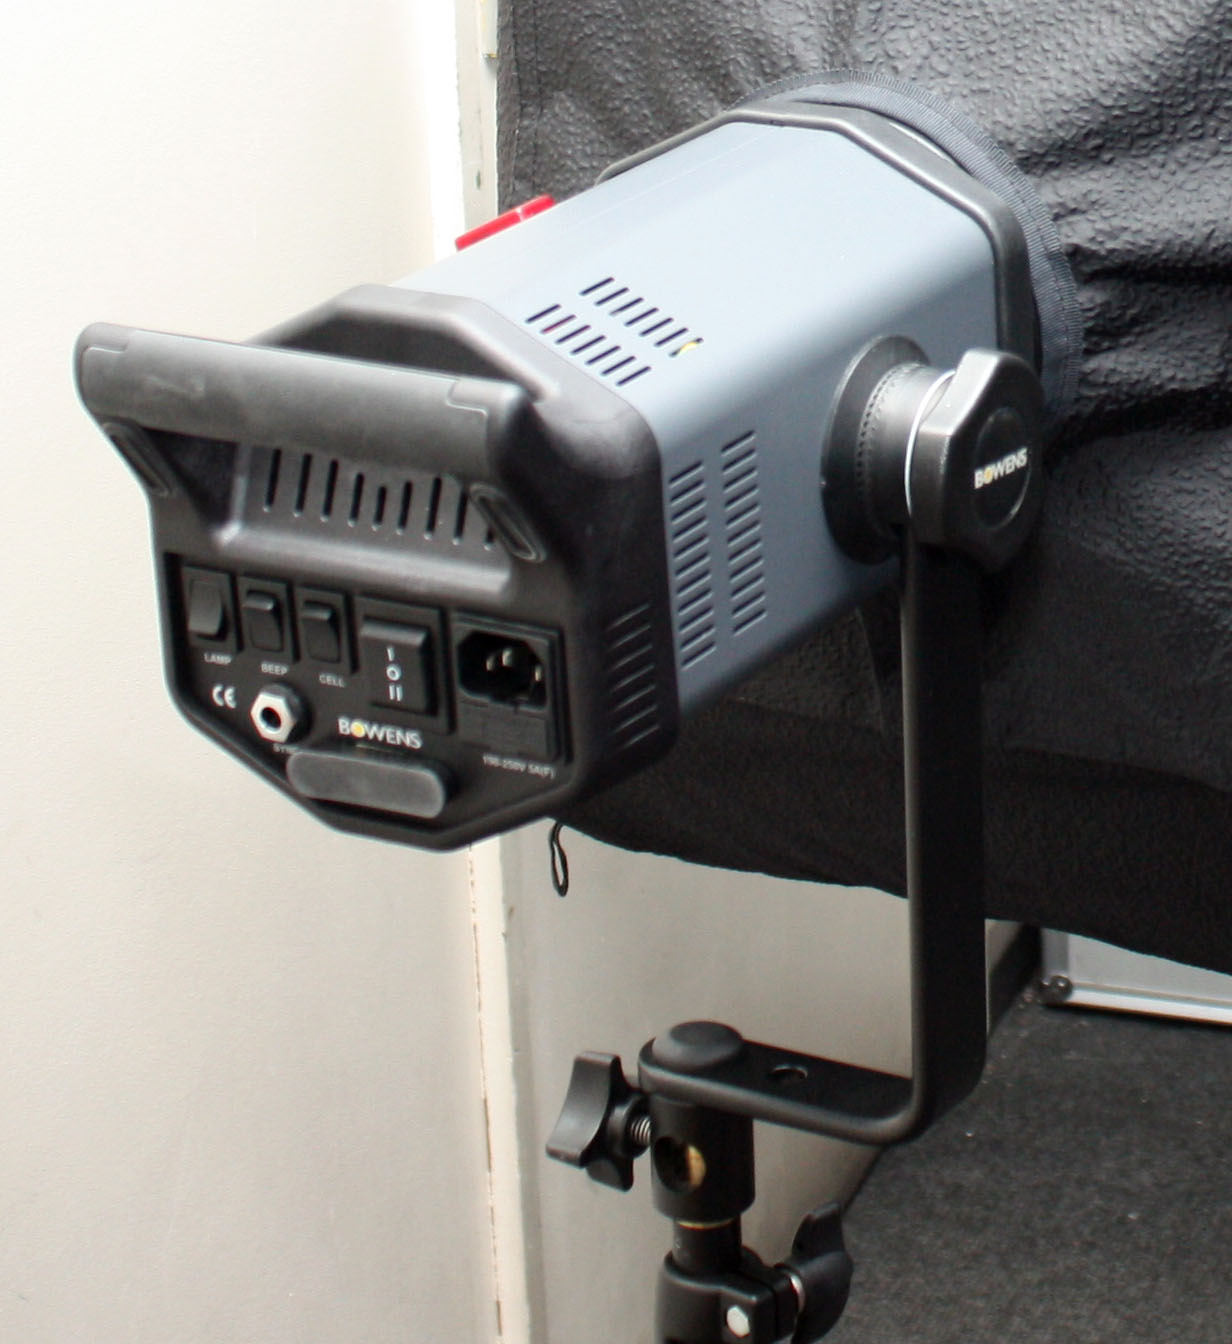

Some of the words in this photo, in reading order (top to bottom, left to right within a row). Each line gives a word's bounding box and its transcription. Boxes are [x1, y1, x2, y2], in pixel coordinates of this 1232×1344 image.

[973, 447, 1029, 489] BOWENS
[203, 652, 232, 665] LAMP
[261, 661, 289, 676] BEEP
[318, 672, 346, 688] CELL
[337, 716, 423, 750] BOWENS
